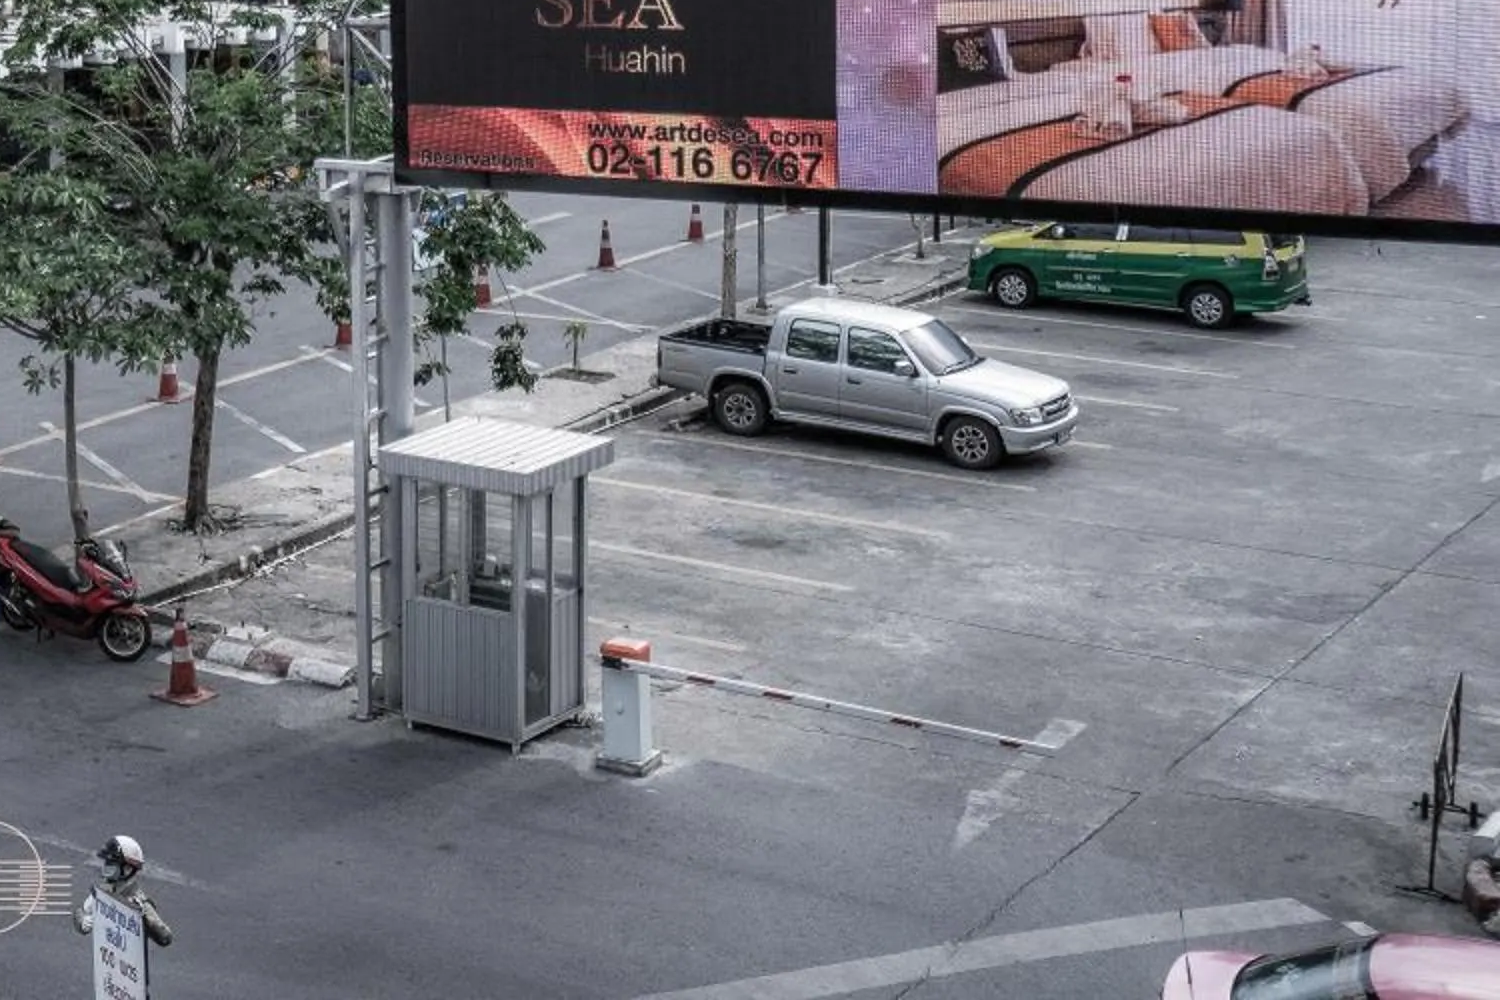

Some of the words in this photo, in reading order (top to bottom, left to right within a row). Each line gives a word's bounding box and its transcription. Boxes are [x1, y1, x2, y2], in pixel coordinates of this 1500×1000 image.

[586, 44, 686, 75] Huahin
[587, 120, 823, 148] www.artdesea.com
[587, 143, 713, 180] 02-116
[731, 148, 824, 184] 6767
